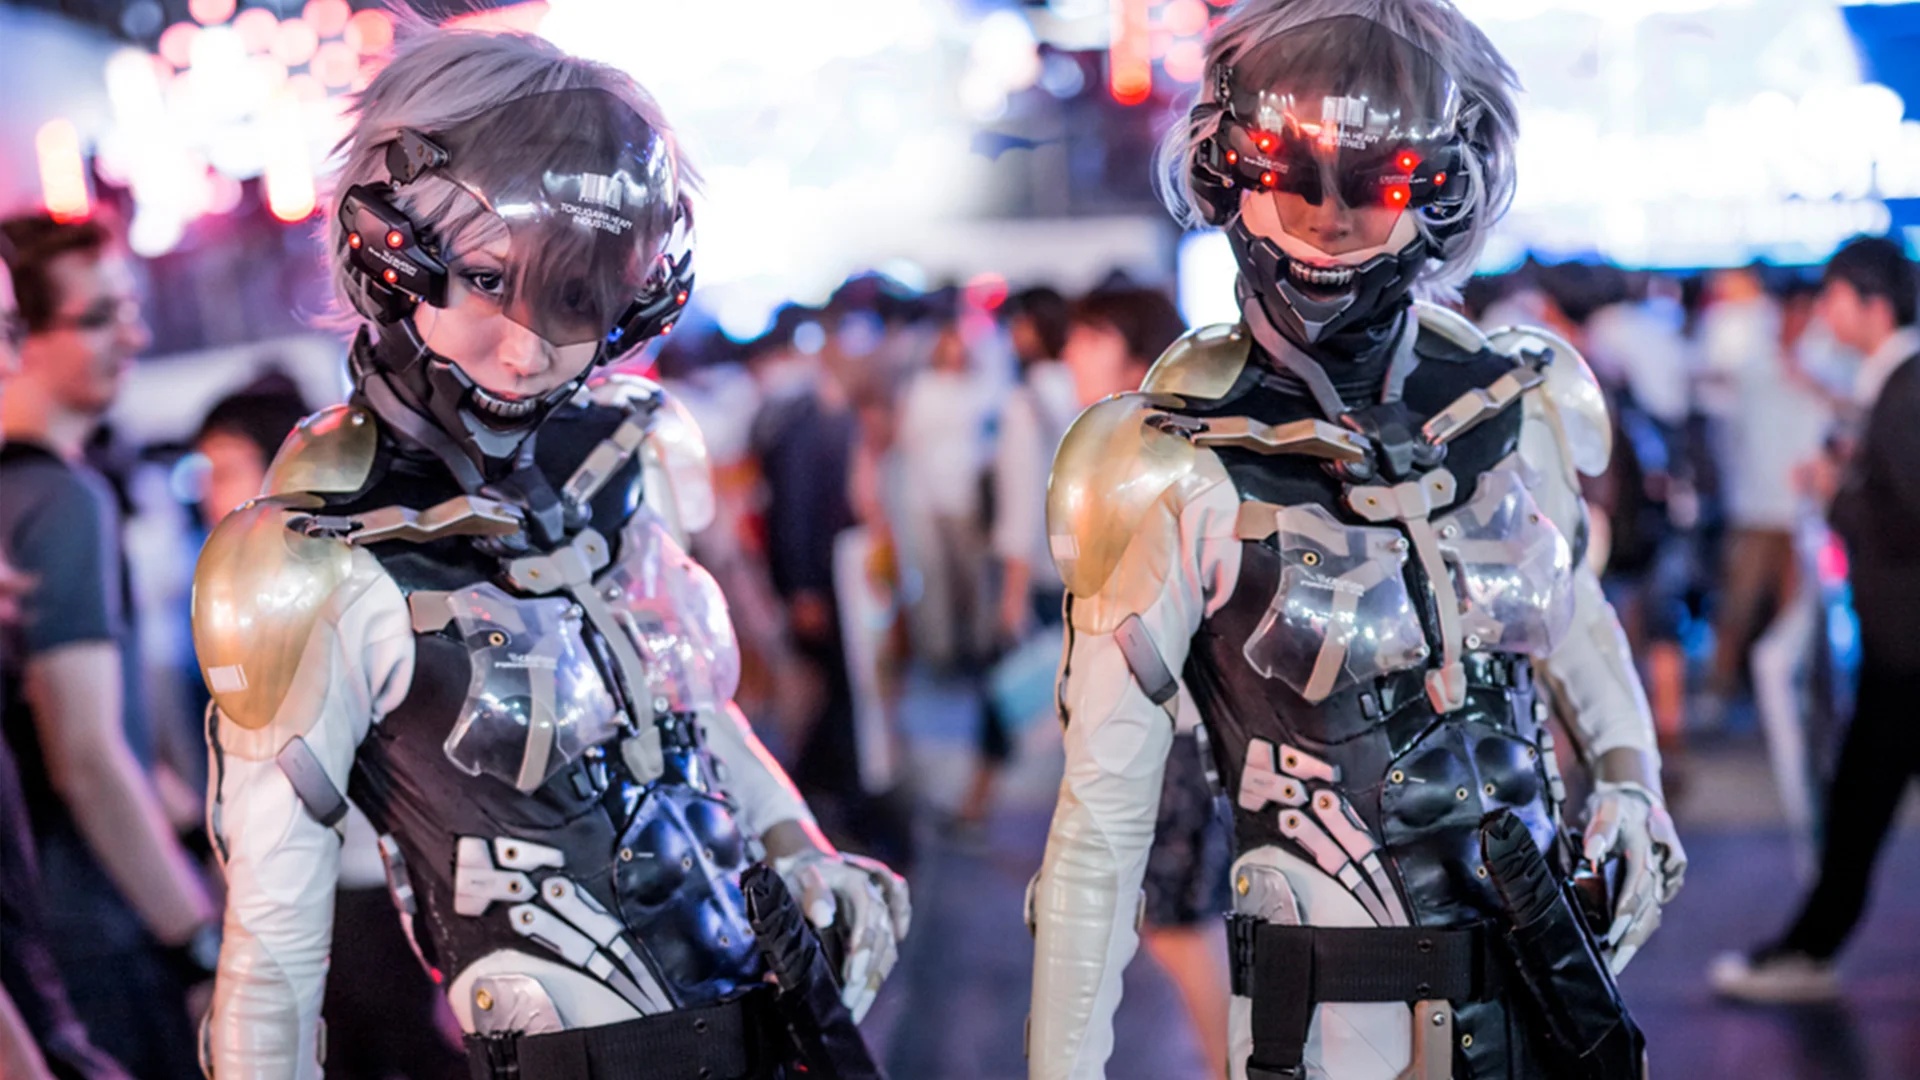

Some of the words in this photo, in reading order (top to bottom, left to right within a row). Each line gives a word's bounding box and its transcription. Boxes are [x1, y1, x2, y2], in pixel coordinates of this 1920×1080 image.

[1352, 133, 1379, 145] HEAVY
[560, 202, 609, 221] TOKUGAWA
[572, 214, 622, 235] INDUSTRIES
